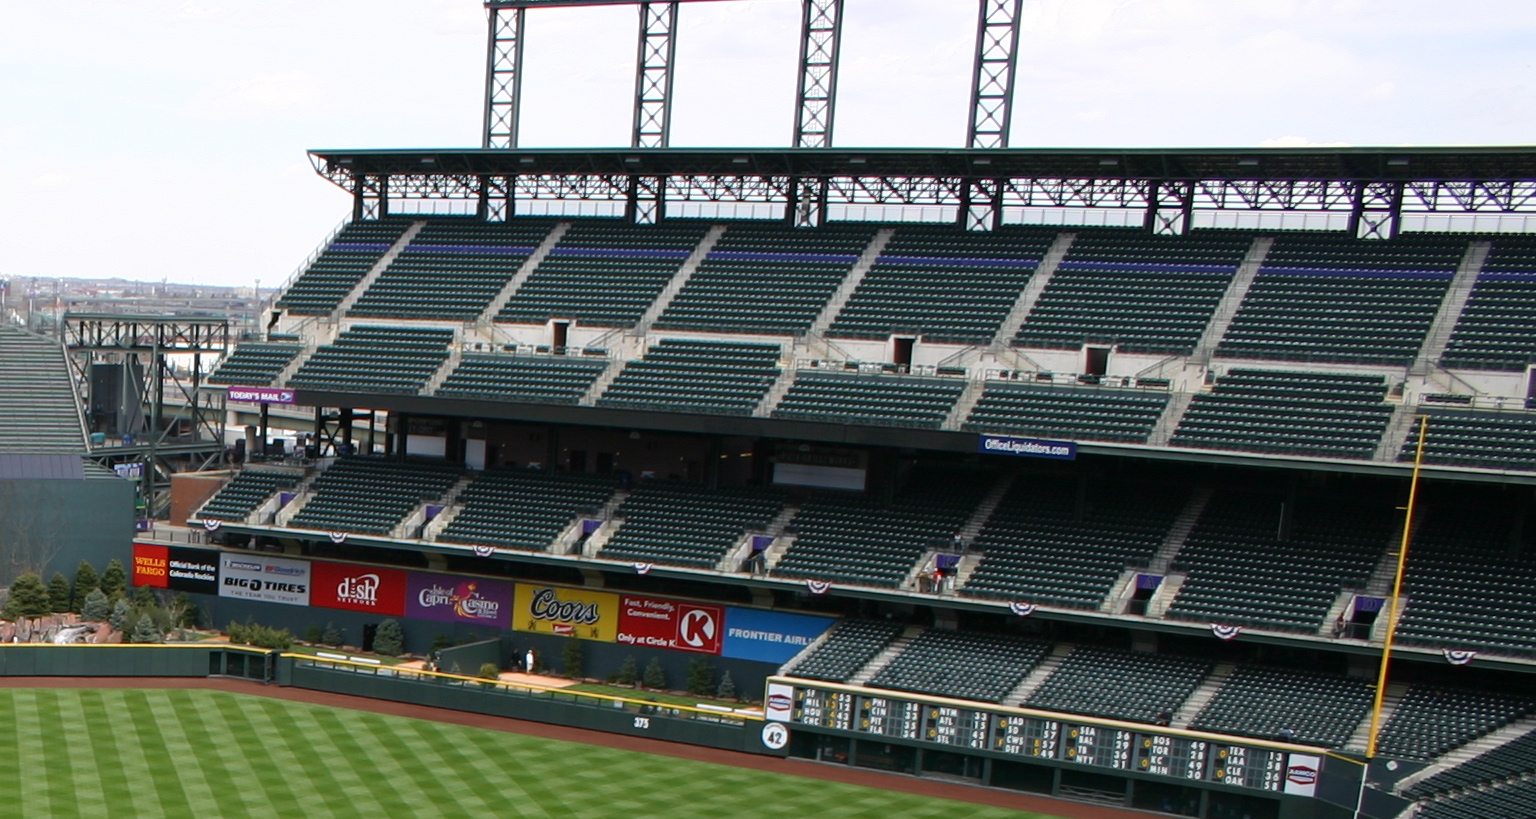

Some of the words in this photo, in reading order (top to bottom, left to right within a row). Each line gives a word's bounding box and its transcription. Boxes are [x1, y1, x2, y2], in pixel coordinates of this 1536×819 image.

[230, 391, 260, 400] TODAY'S
[261, 392, 279, 401] MAIL
[985, 439, 1069, 455] OfficeLiquidators.com
[135, 557, 166, 567] WELLS
[169, 560, 188, 569] Official
[188, 562, 200, 570] Bank
[206, 564, 216, 572] the
[136, 566, 165, 576] FARGO
[169, 569, 194, 579] Colorado
[224, 577, 249, 587] BIG
[264, 581, 306, 593] TIRES
[337, 574, 379, 600] dish
[337, 597, 376, 606] NETWORK
[462, 592, 499, 614] Casino
[530, 587, 600, 625] Coors
[625, 598, 642, 608] Fast,
[686, 612, 713, 647] K
[618, 632, 636, 644] Only
[637, 636, 645, 644] at
[646, 636, 667, 647] Circle
[728, 628, 783, 643] FRONTIER
[804, 707, 821, 717] HOU
[633, 716, 650, 729] 375
[1008, 716, 1024, 726] LAD
[1044, 730, 1056, 740] 57
[1080, 726, 1095, 736] SEA
[767, 731, 782, 745] 42
[1153, 736, 1170, 746] BOS
[1152, 745, 1168, 755] TOR
[1229, 746, 1245, 756] TEX
[1269, 752, 1282, 761] 13
[1150, 755, 1163, 765] KC
[1227, 756, 1244, 765] LAA
[1149, 765, 1168, 775] MIN
[1187, 770, 1201, 780] 30
[1226, 766, 1241, 776] CLE
[1225, 776, 1244, 786] OAK
